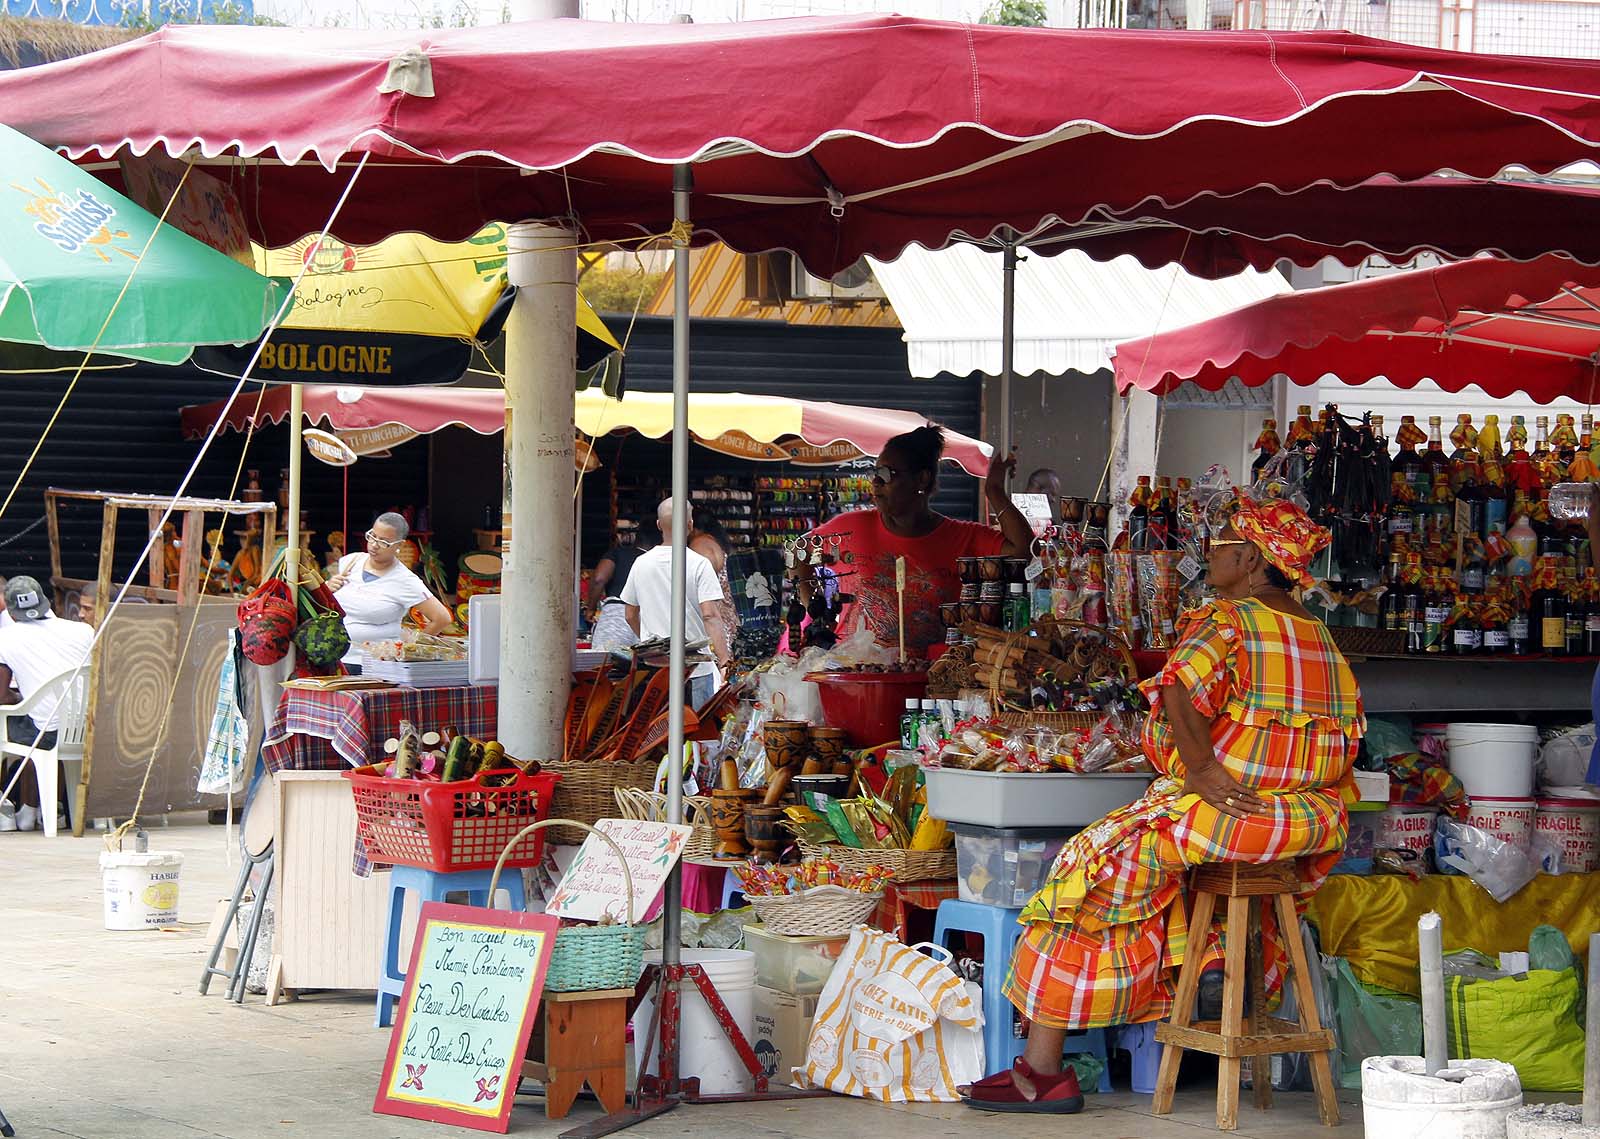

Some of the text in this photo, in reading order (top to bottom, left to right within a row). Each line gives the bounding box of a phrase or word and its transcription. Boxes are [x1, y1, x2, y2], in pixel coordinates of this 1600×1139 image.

[259, 342, 392, 374] BOLOGNE
[1535, 816, 1582, 832] FRAGILE
[436, 927, 536, 957] Bon accueil chez
[435, 945, 469, 977] Mamie
[412, 982, 444, 1016] Fleur
